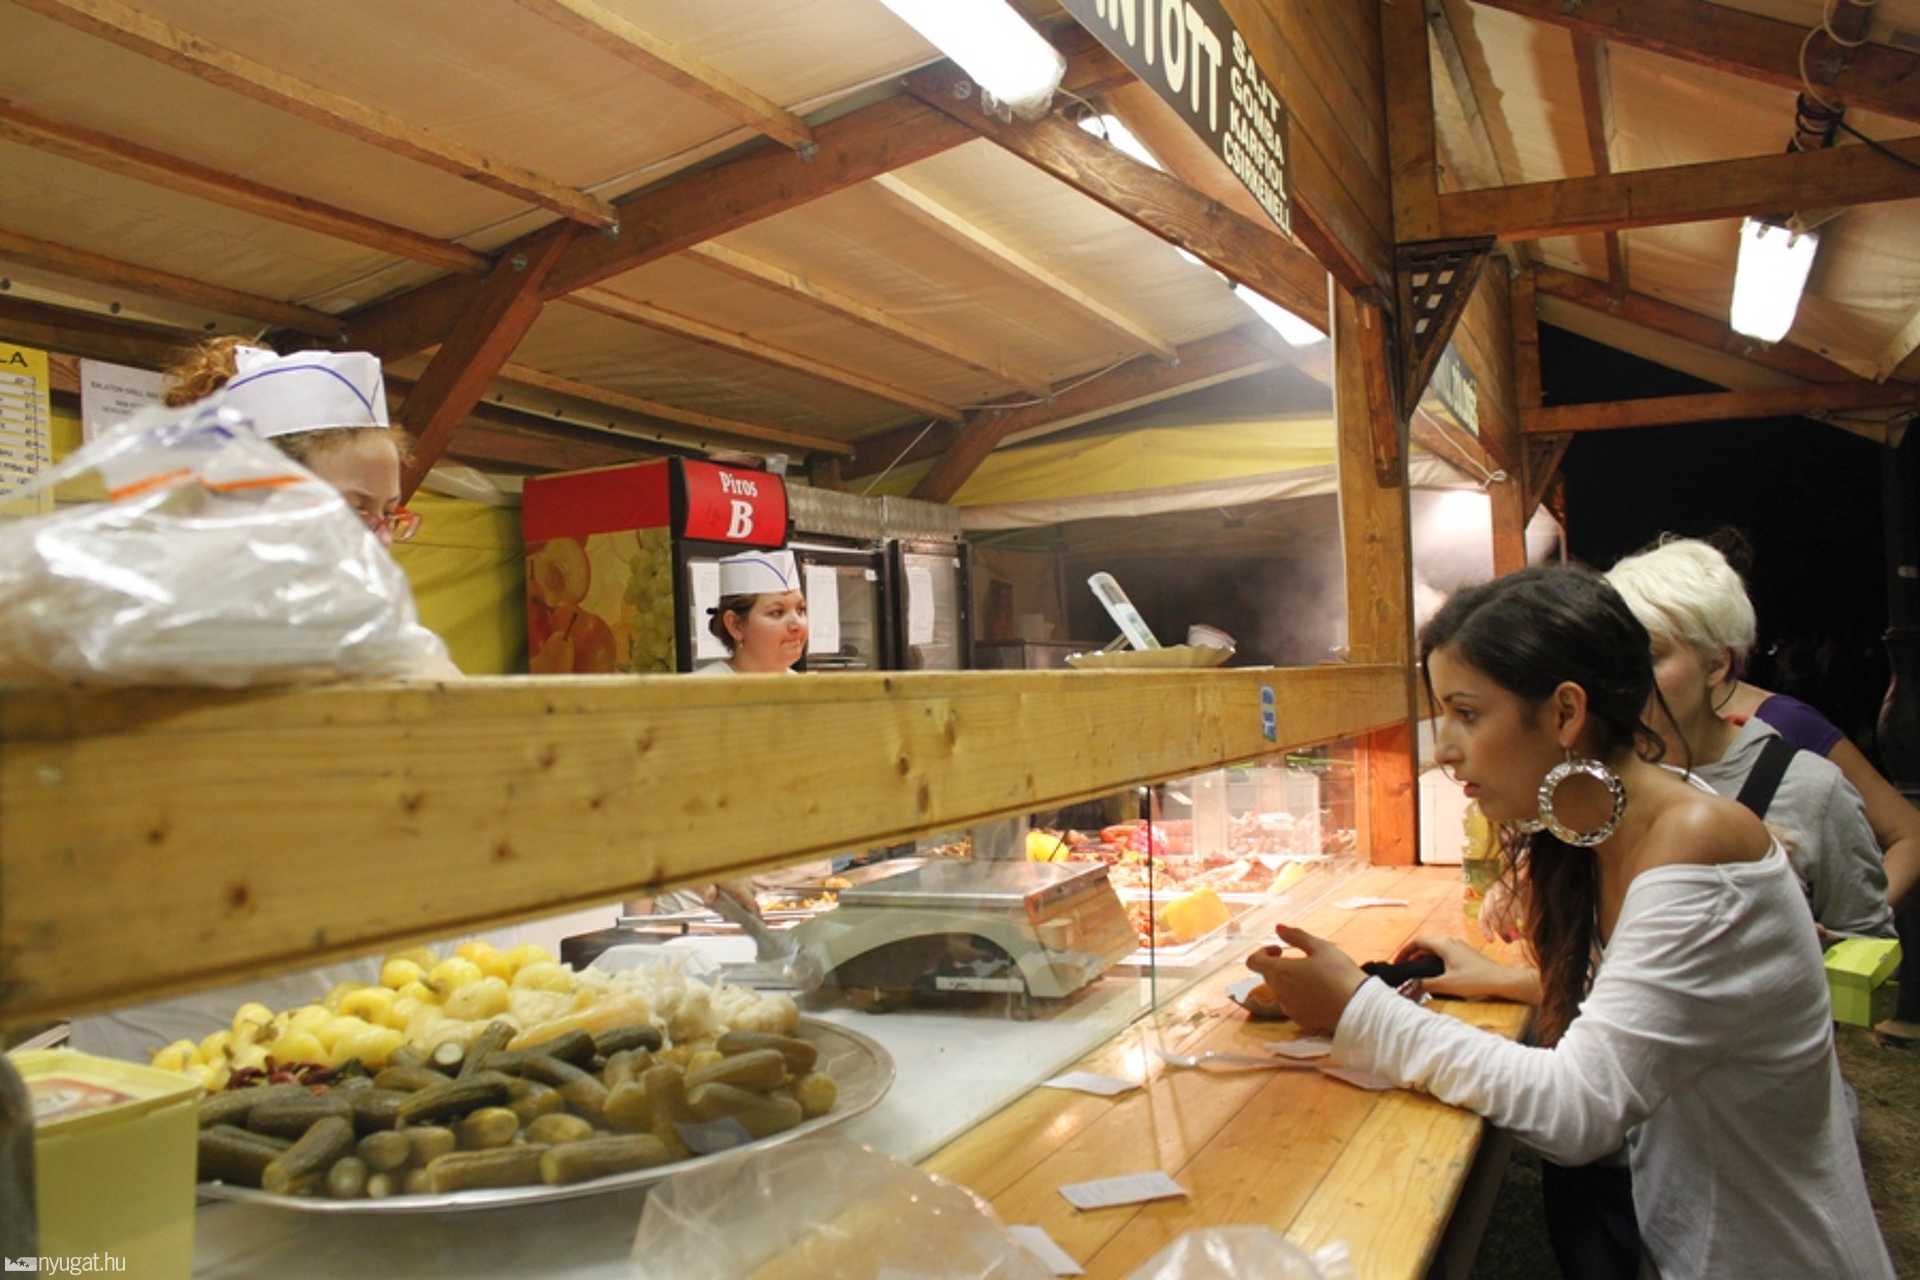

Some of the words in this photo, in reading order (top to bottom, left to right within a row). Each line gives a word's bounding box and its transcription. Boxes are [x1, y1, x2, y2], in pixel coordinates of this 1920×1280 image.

[1230, 66, 1284, 165] GOMBA
[1232, 30, 1280, 122] SAJT
[1230, 101, 1287, 201] KARFIOL
[719, 471, 758, 498] Piros
[726, 500, 754, 538] B
